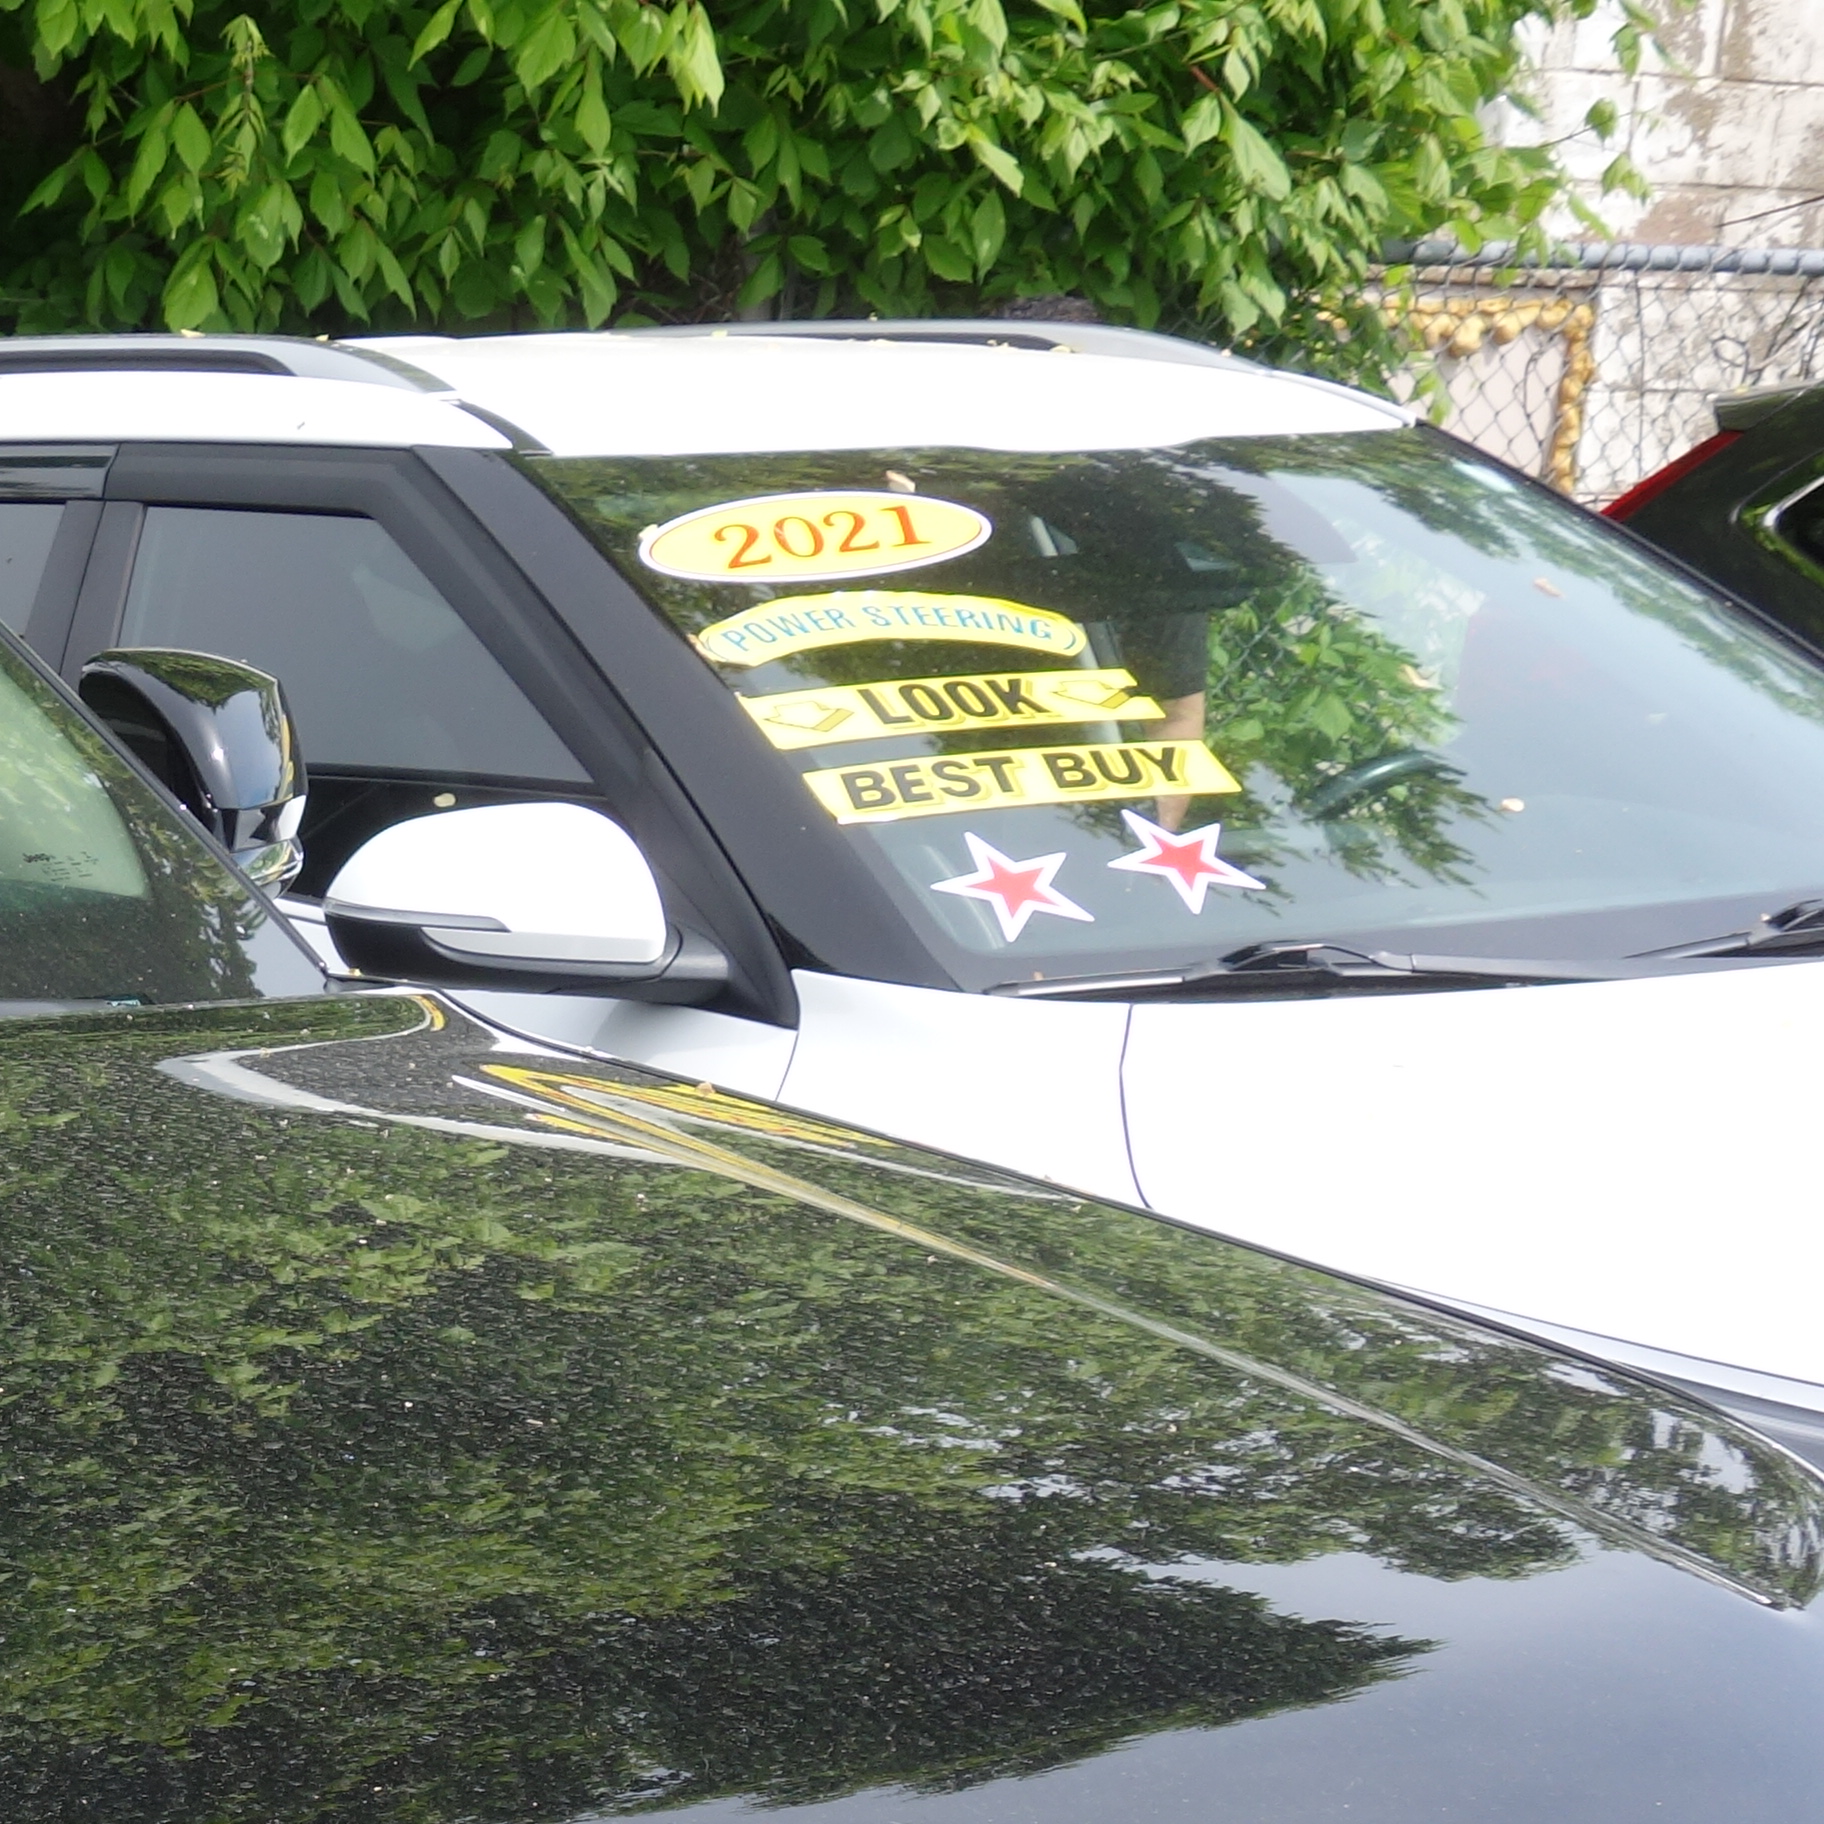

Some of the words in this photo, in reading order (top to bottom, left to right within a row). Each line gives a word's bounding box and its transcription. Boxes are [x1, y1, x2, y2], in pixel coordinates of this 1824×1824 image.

[713, 506, 931, 569] 2021
[722, 608, 855, 652] POWER
[870, 605, 1054, 642] STEERING
[857, 677, 1054, 727] LOOK
[841, 756, 1021, 810] BEST
[1043, 746, 1185, 790] BUY
